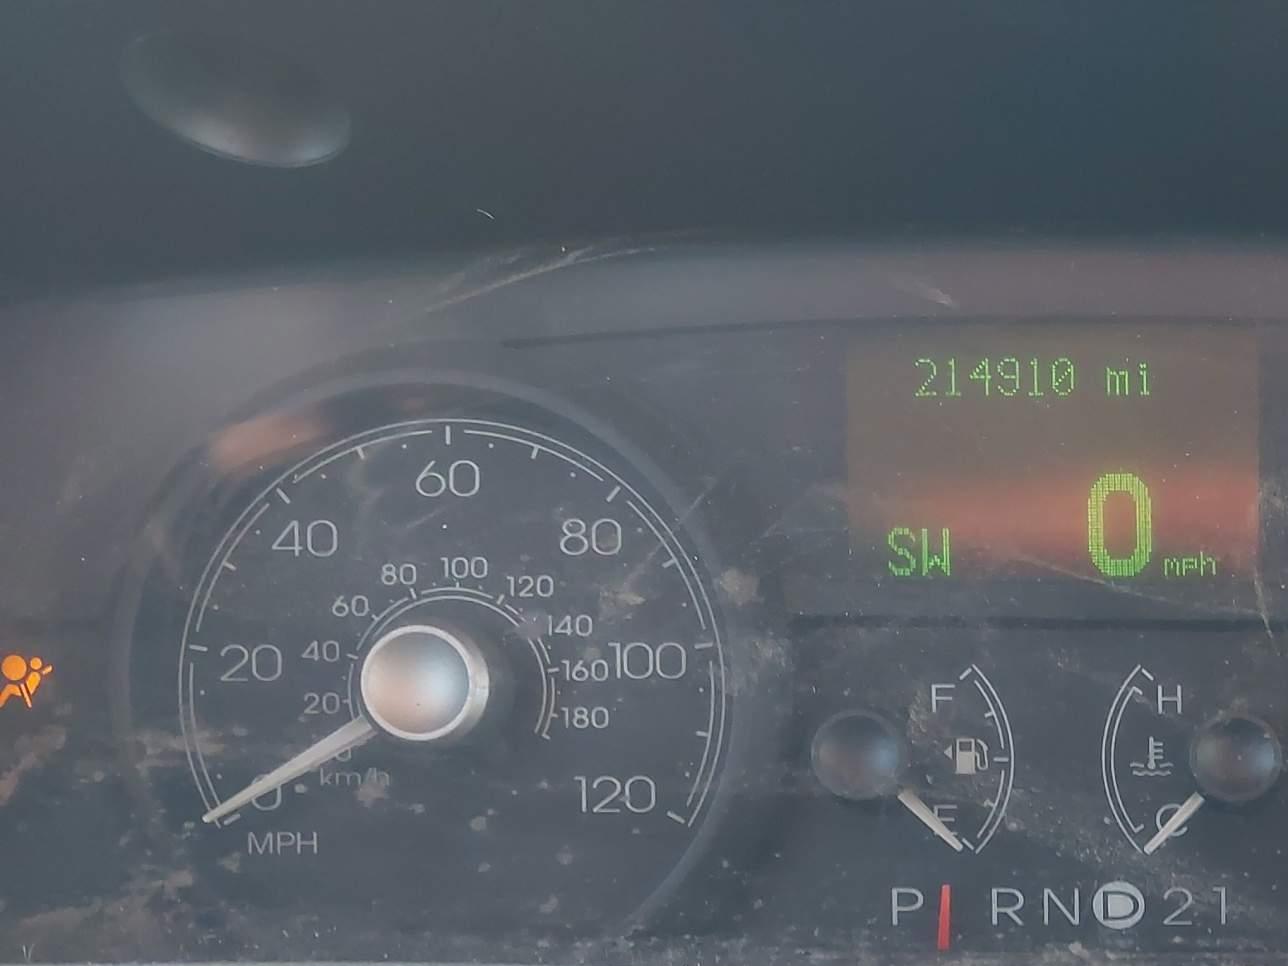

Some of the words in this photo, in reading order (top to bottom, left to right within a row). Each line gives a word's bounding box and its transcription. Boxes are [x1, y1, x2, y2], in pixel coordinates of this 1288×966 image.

[914, 358, 1075, 396] 214910
[1106, 362, 1151, 396] mi
[415, 459, 481, 498] 60
[271, 520, 338, 557] 40
[559, 518, 622, 556] 80
[1088, 473, 1152, 576] 0
[888, 528, 950, 576] SW
[1164, 551, 1216, 577] mph
[381, 564, 417, 586] 80
[441, 557, 488, 580] 100
[506, 576, 554, 598] 120
[332, 595, 369, 617] 60
[546, 615, 592, 637] 140
[220, 644, 283, 682] 20
[302, 641, 340, 663] 40
[611, 641, 687, 680] 100
[561, 660, 609, 682] 160
[303, 692, 340, 714] 20
[929, 684, 956, 713] F
[1157, 685, 1183, 714] H
[561, 707, 609, 729] 180
[574, 776, 656, 813] 120
[248, 832, 318, 854] MPH
[891, 888, 924, 926] P
[991, 888, 1024, 926] R
[1043, 888, 1080, 926] N
[1100, 888, 1141, 924] D
[1163, 888, 1193, 925] 2
[1213, 887, 1226, 924] 1
